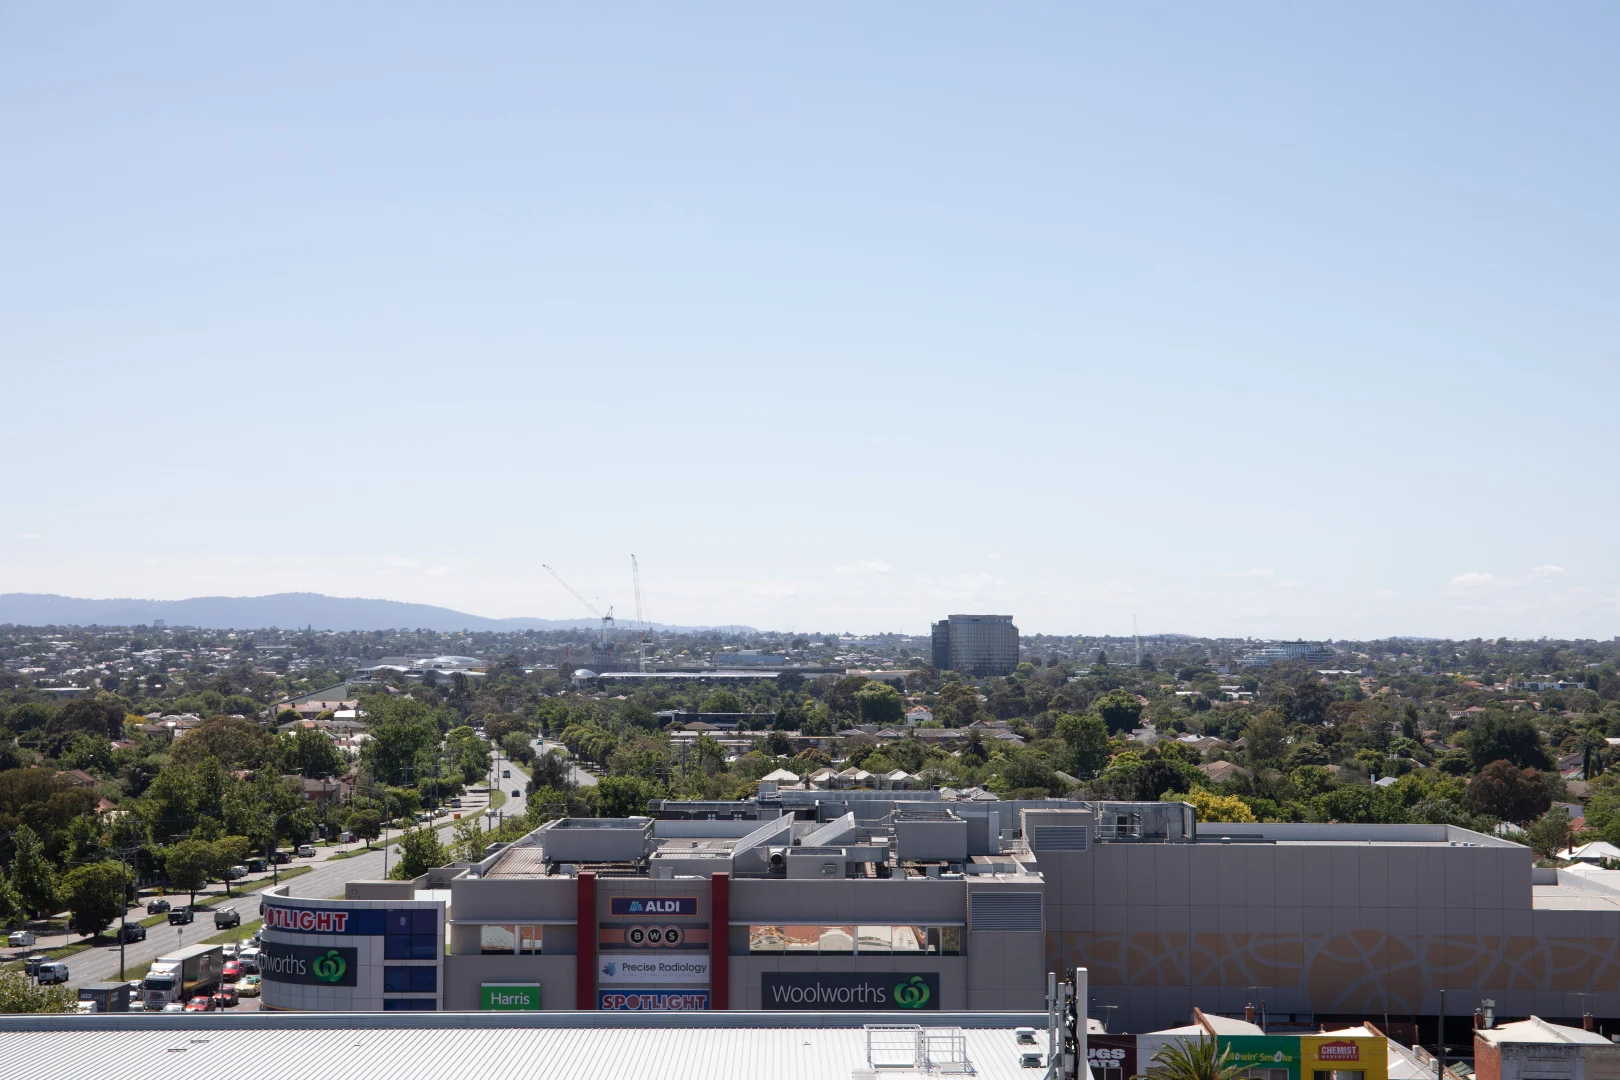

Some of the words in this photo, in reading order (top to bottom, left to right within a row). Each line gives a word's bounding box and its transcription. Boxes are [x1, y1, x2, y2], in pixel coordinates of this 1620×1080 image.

[645, 901, 680, 912] ALDI
[634, 931, 676, 940] BWS
[622, 962, 657, 972] Precise
[659, 962, 707, 974] Radiology
[490, 992, 530, 1005] Harris
[772, 982, 886, 1003] Woolworths
[602, 994, 707, 1010] SPOTLIGHT
[1259, 1050, 1293, 1063] Smoke
[1321, 1046, 1357, 1055] CHEMIST
